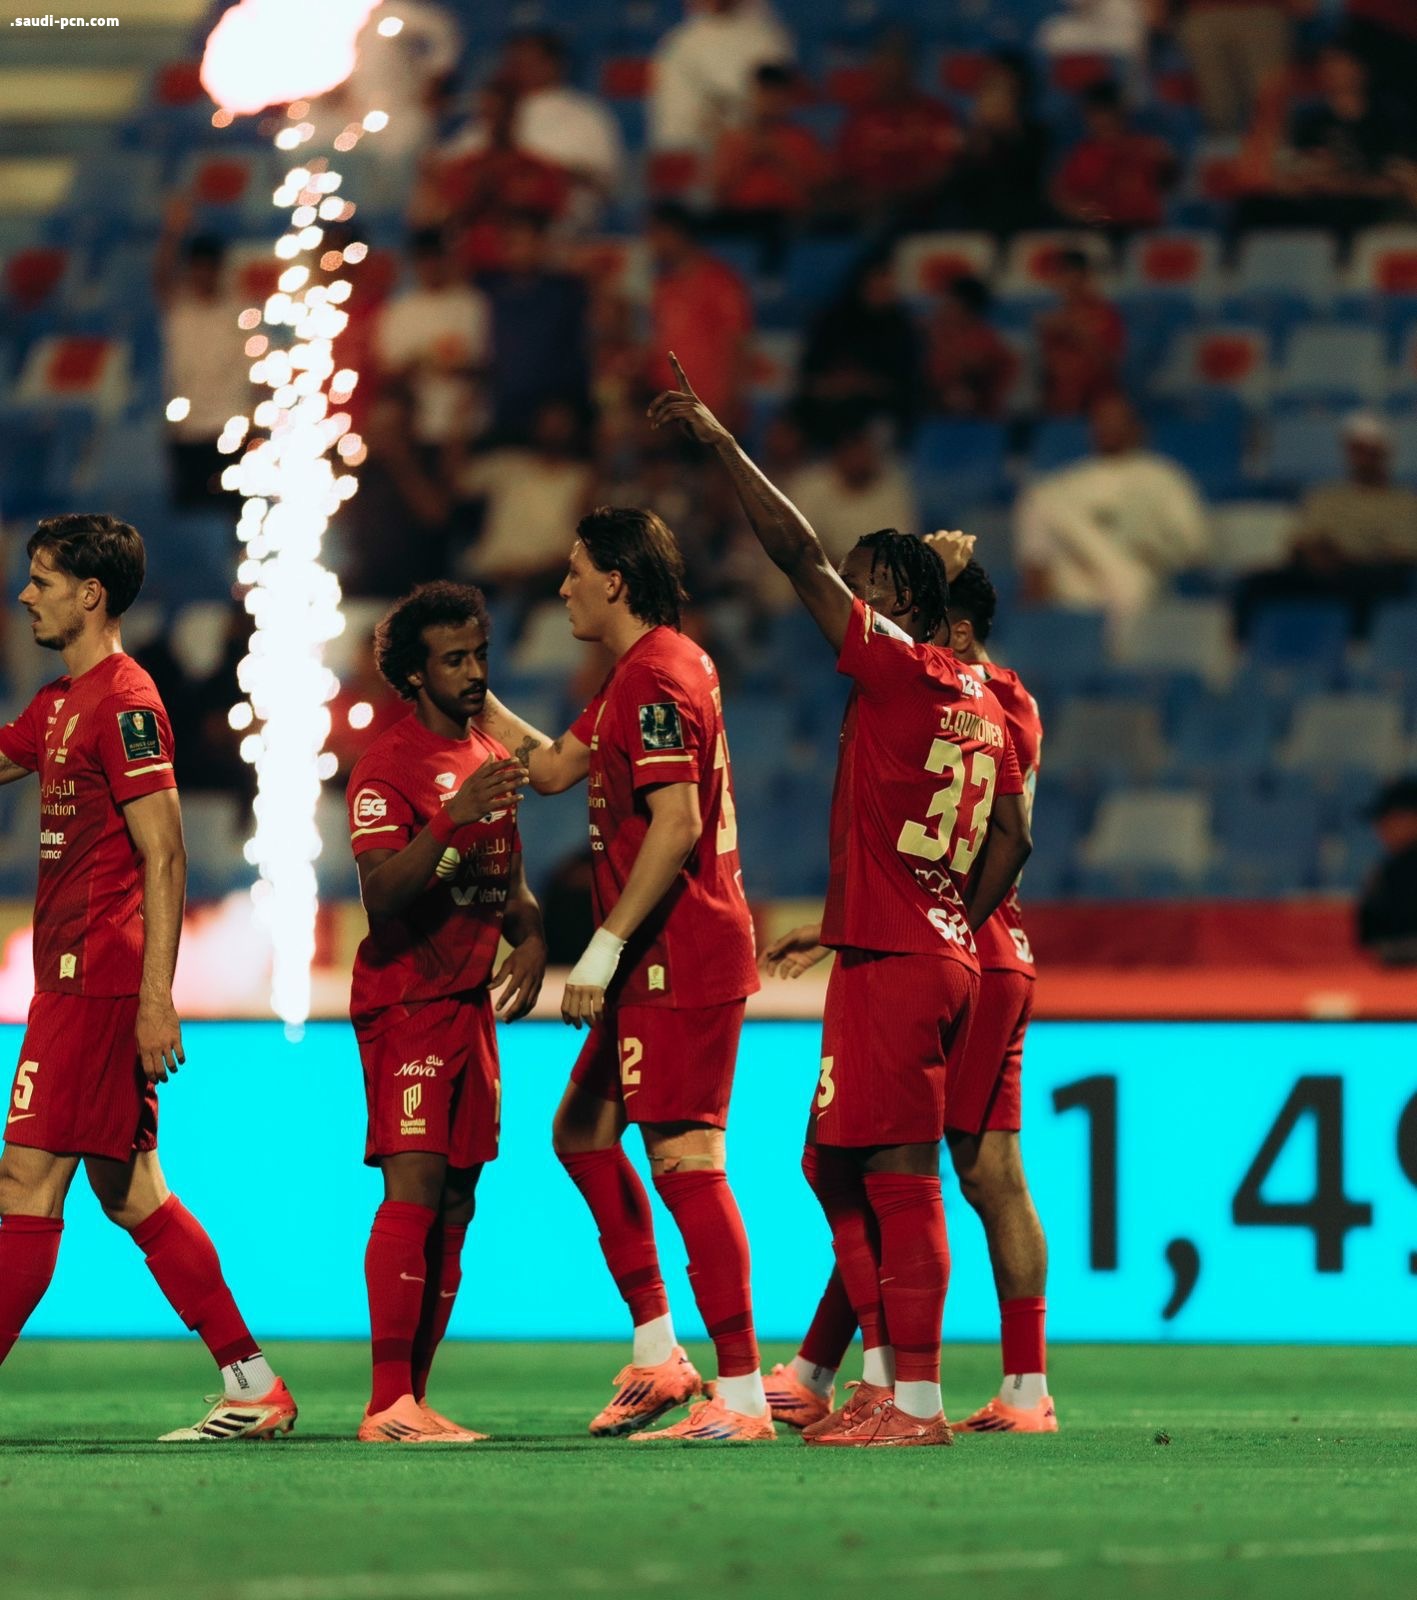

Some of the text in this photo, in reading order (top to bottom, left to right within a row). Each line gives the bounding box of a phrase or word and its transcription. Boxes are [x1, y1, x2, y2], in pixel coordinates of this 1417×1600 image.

[897, 738, 998, 875] 33
[393, 1060, 437, 1077] Nova
[618, 1037, 643, 1084] 2
[14, 1060, 39, 1110] 5
